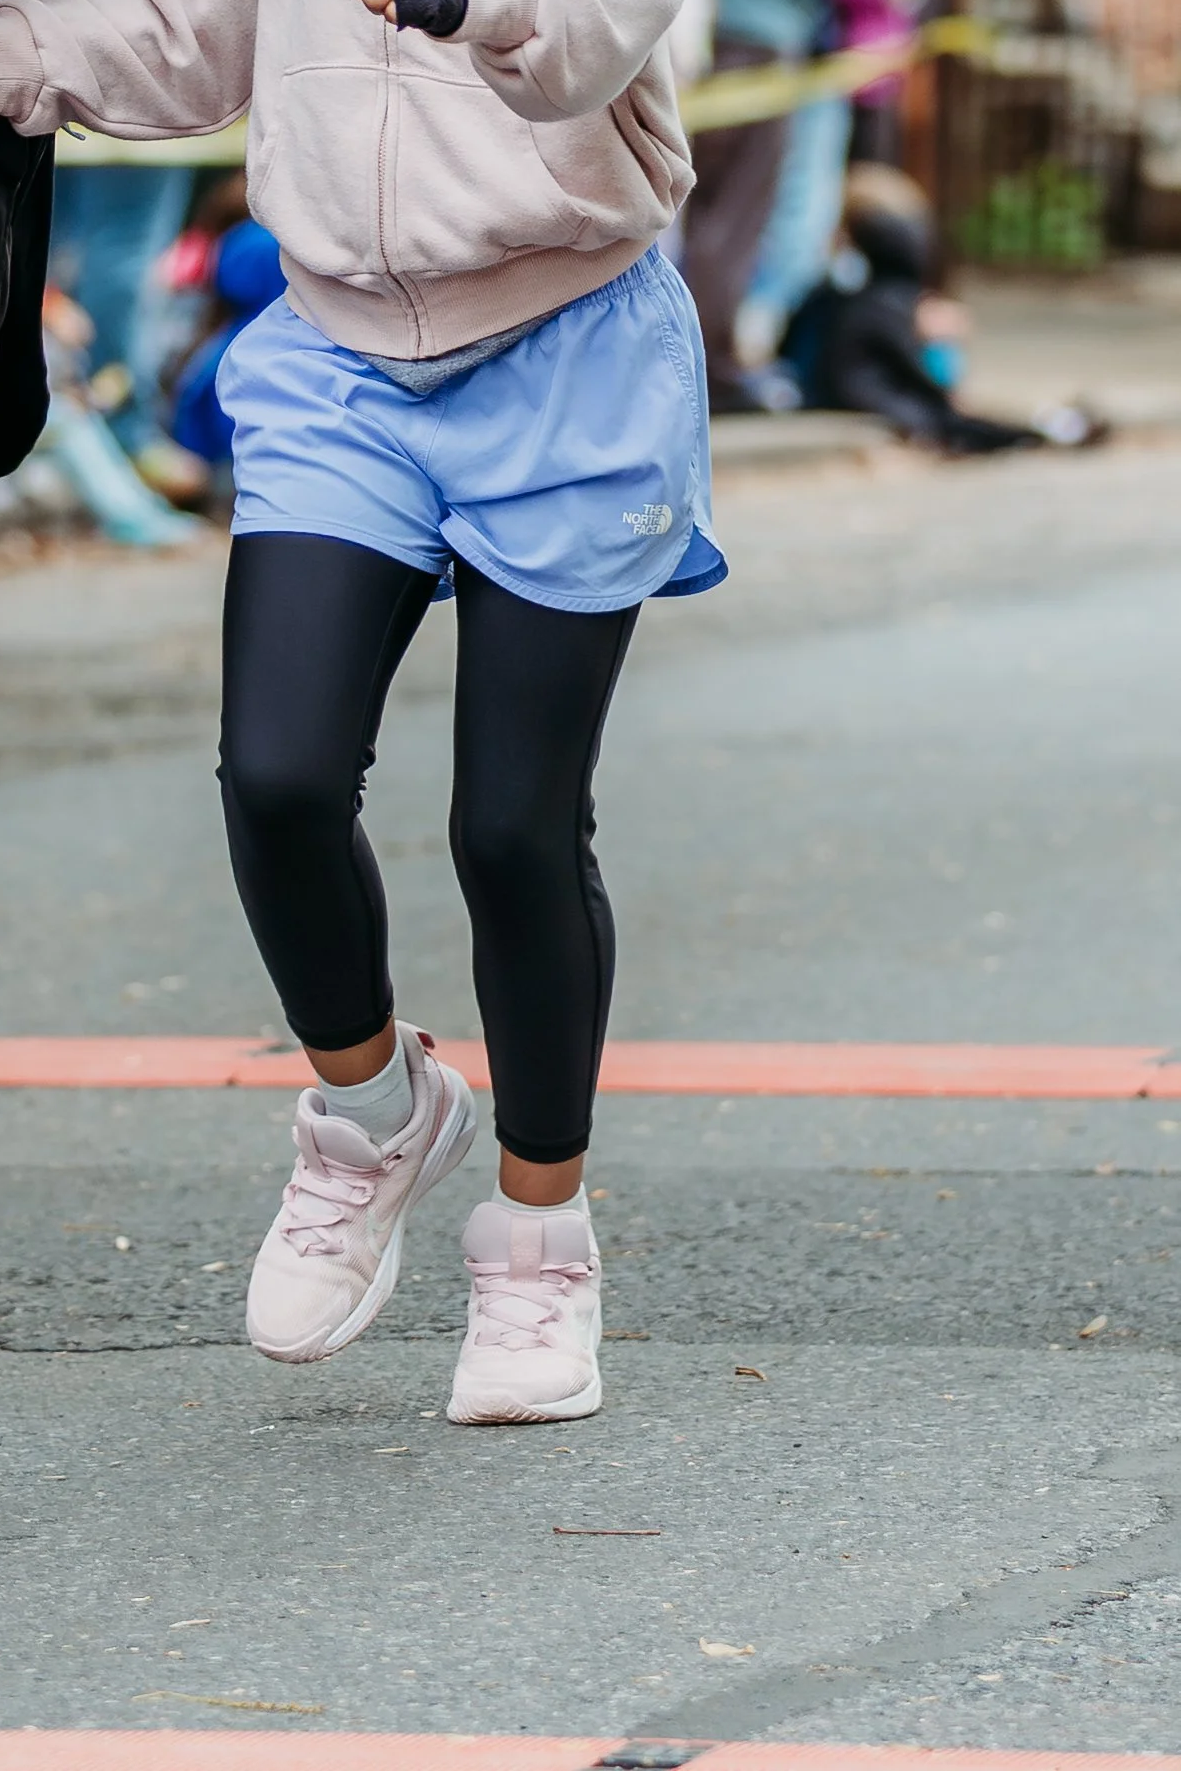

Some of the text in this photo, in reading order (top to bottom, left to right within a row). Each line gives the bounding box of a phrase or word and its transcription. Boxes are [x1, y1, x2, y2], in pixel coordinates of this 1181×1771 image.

[642, 503, 663, 515] THE
[622, 512, 660, 525] NORTH
[633, 524, 658, 535] FACE
